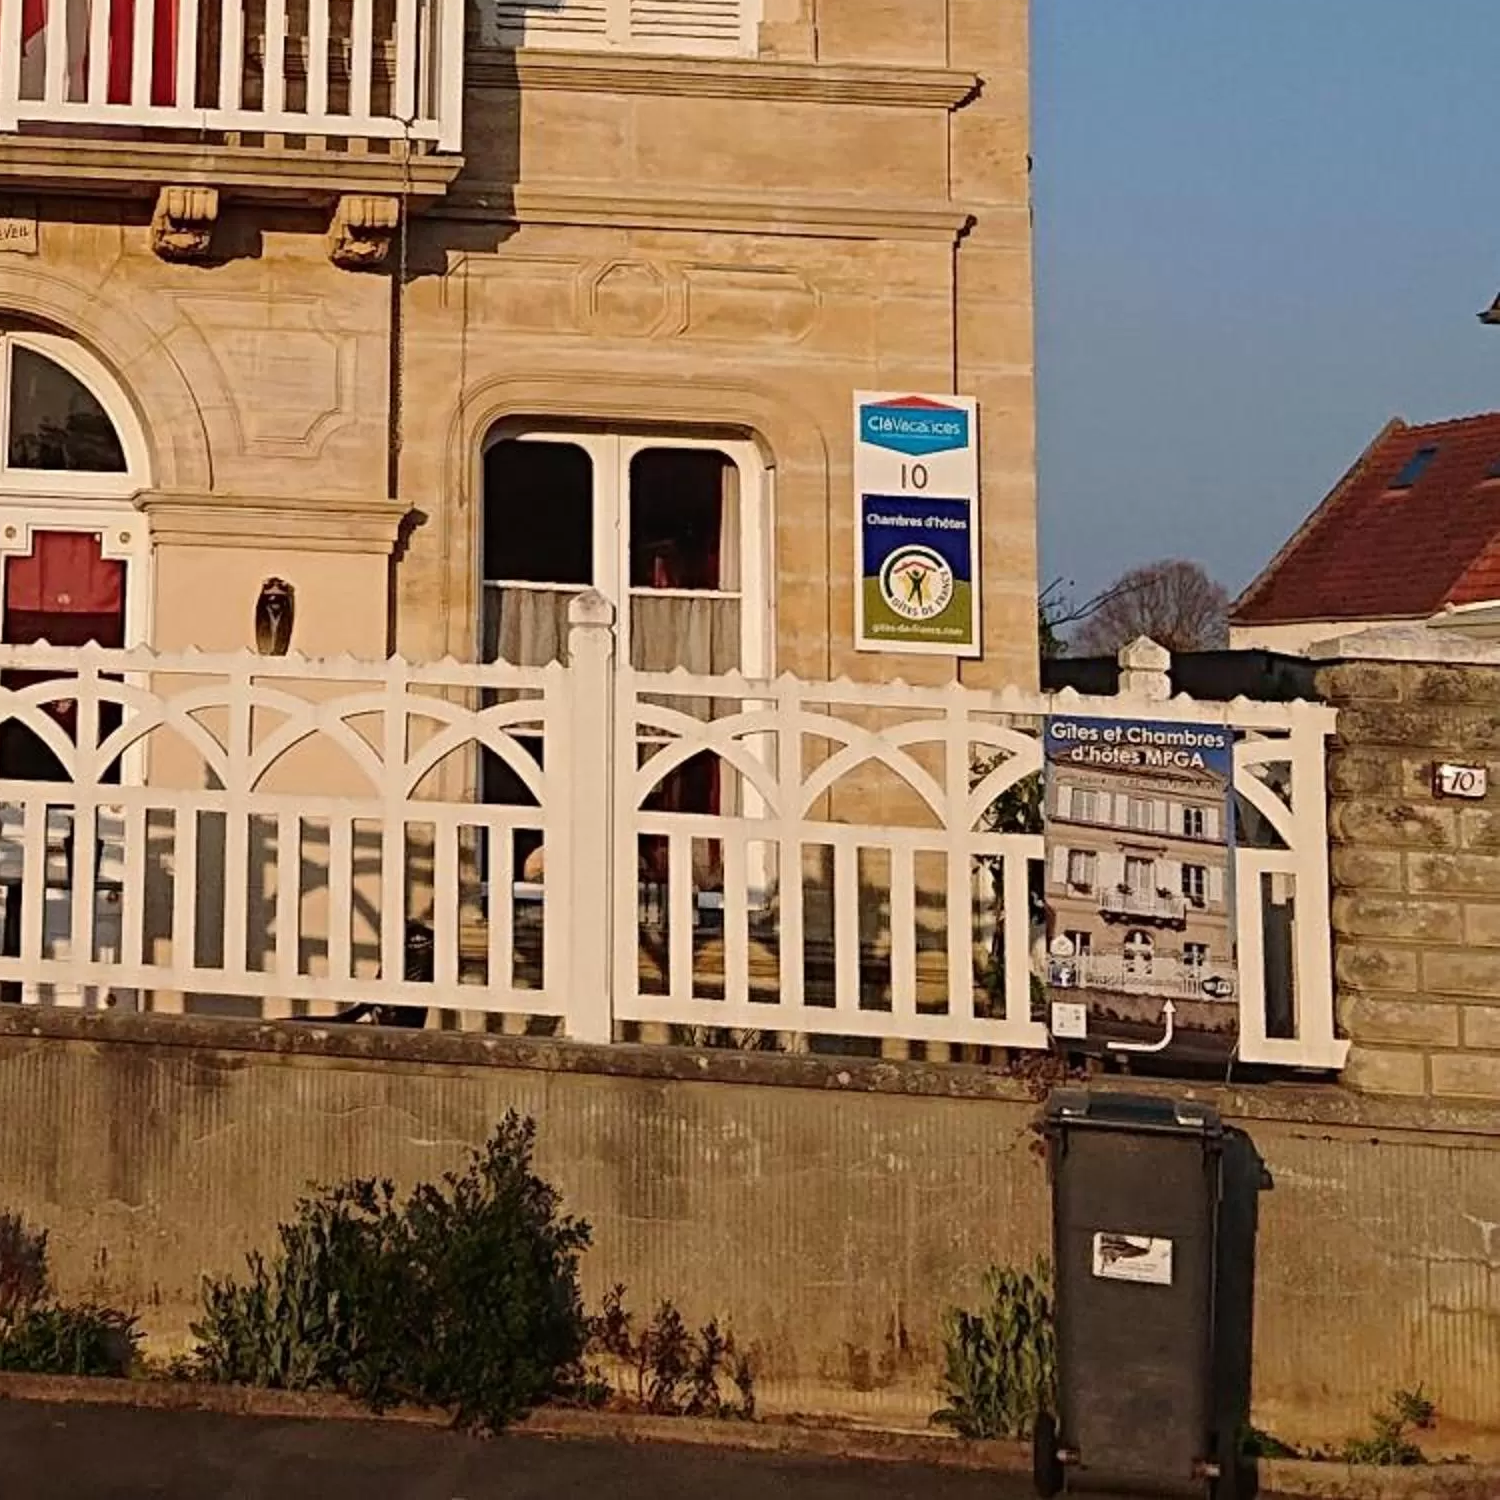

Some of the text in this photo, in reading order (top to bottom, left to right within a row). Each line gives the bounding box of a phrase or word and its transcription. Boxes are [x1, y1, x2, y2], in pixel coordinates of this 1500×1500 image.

[902, 463, 928, 489] 10
[866, 513, 922, 527] Chambres
[1051, 722, 1225, 748] Gîtes et Chambres
[1071, 745, 1205, 769] d'hôtes MPGA
